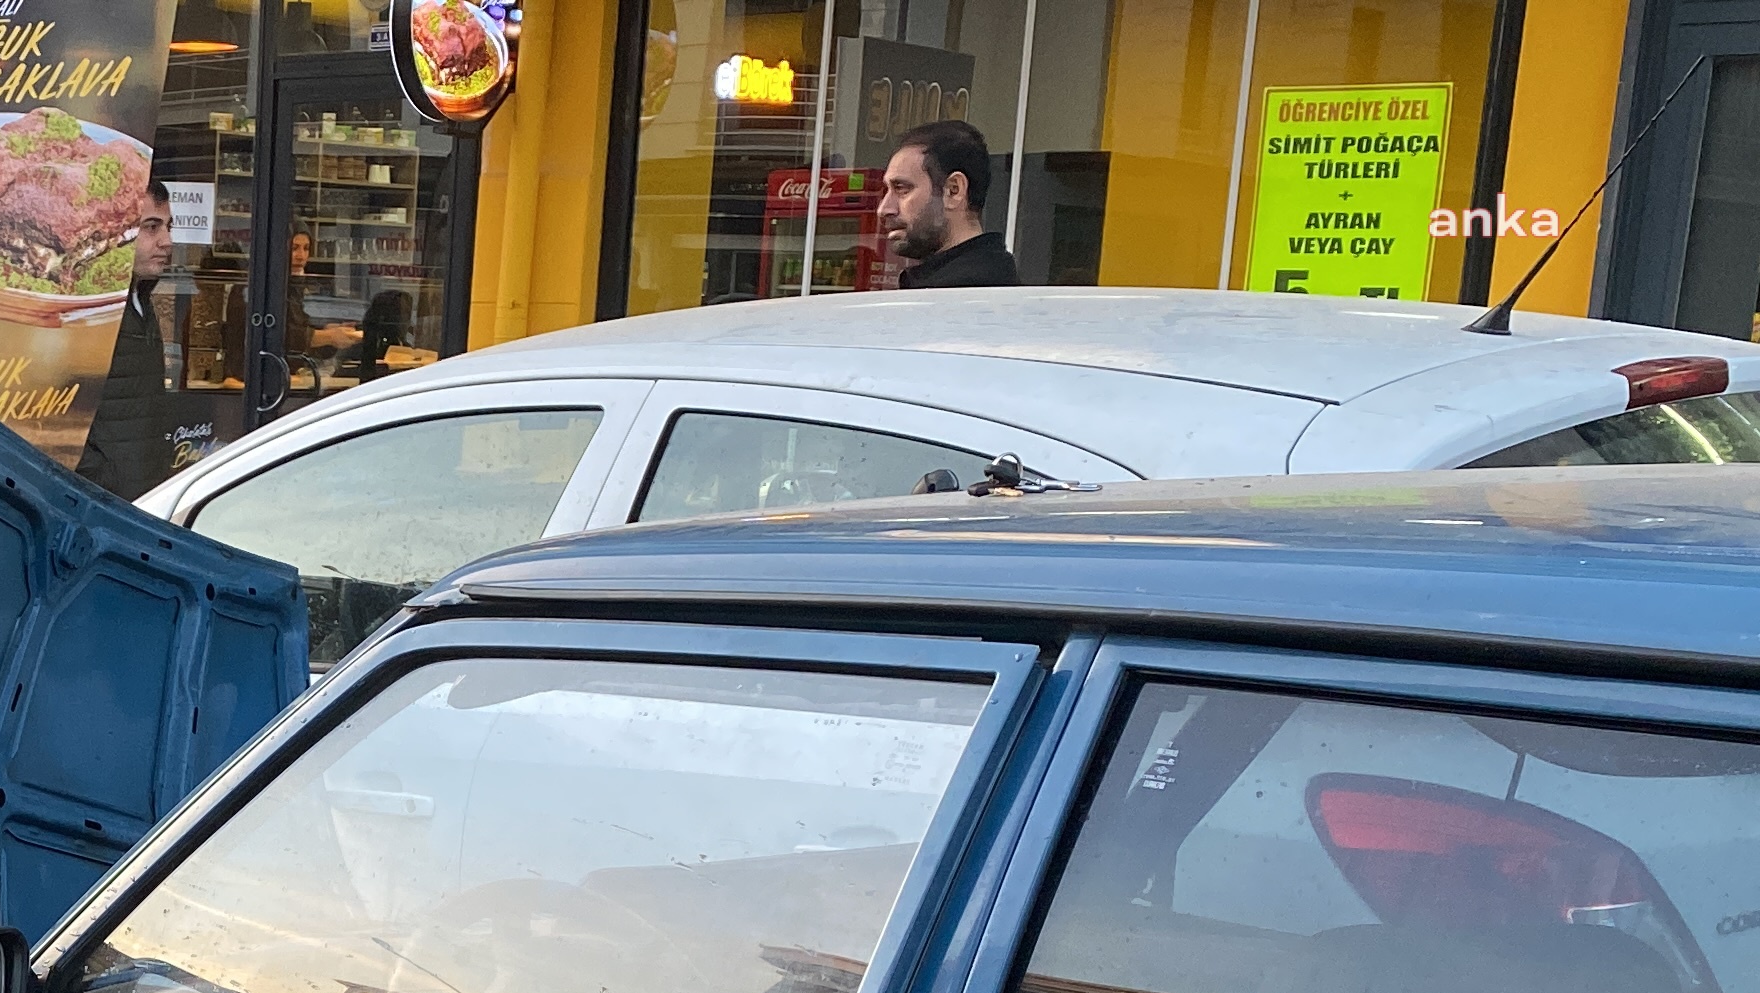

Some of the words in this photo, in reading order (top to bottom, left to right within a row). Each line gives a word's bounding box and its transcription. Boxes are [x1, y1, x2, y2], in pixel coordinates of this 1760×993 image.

[1279, 97, 1381, 123] ÖĞRENCİYE
[1387, 98, 1430, 121] ÖZEL
[1268, 133, 1336, 155] SİMİT
[1341, 131, 1440, 156] POĞAÇA
[1304, 158, 1400, 180] TÜRLERİ
[172, 215, 208, 228] NIYOR
[1305, 212, 1381, 230] AYRAN
[1289, 237, 1343, 255] VEYA
[1349, 237, 1395, 257] ÇAY
